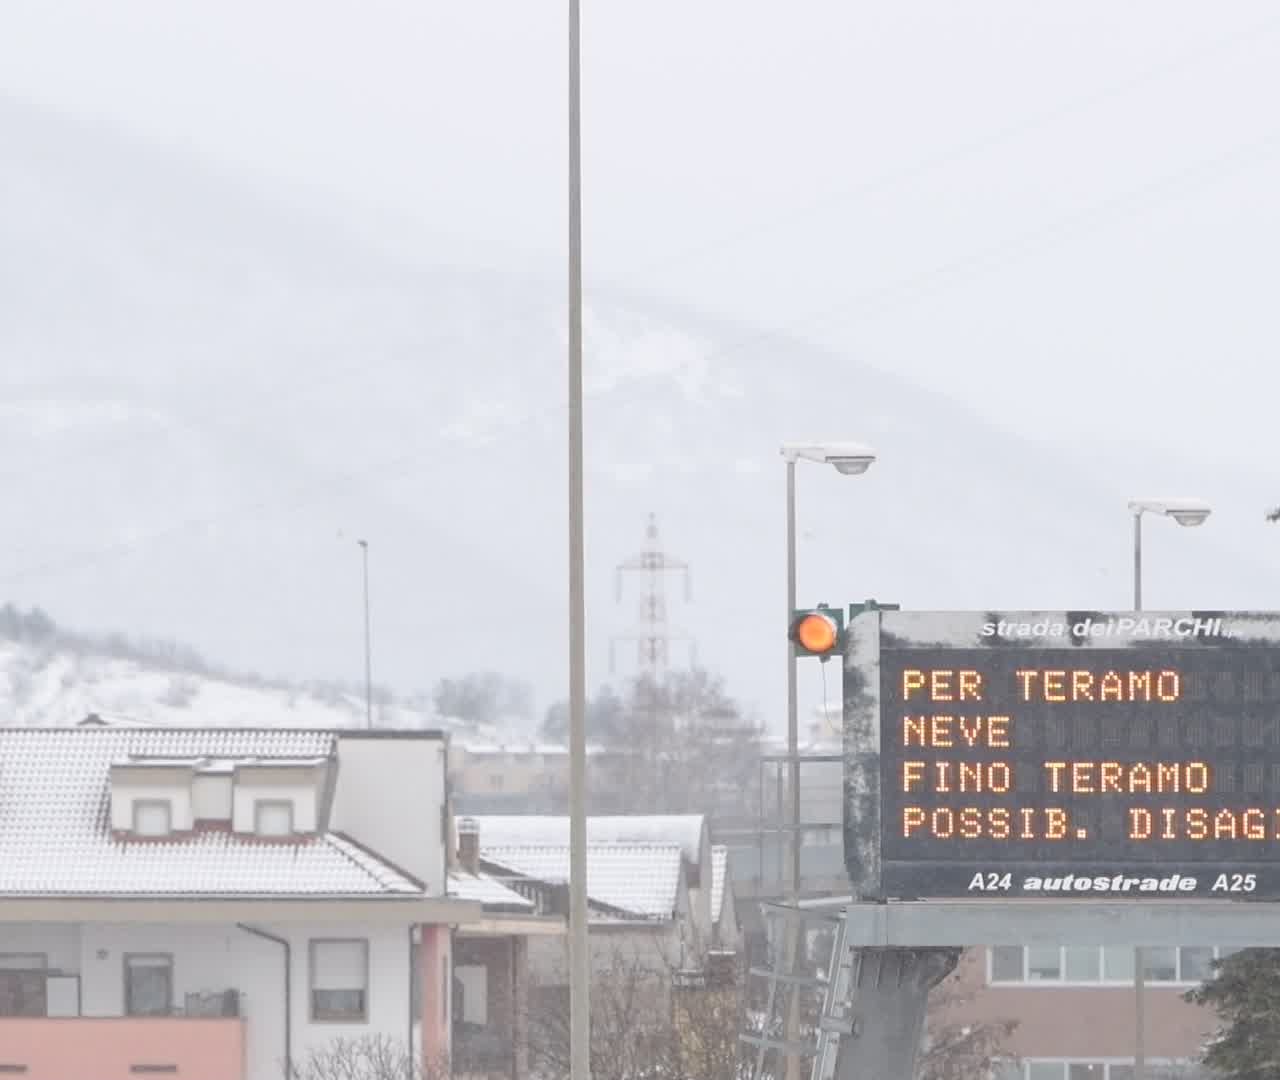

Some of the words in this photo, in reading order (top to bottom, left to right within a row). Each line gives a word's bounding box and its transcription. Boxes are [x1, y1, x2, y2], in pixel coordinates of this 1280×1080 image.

[982, 618, 1064, 636] strada
[1116, 618, 1221, 636] PARCHI
[903, 670, 982, 700] PER
[1016, 670, 1180, 700] TERAMO
[903, 716, 1010, 746] NEVE
[903, 762, 1010, 792] FINO
[1044, 762, 1208, 792] TERAMO
[903, 808, 1087, 838] POSSIB.
[968, 872, 1012, 891] A24
[1023, 874, 1198, 892] autostrade
[1211, 873, 1257, 892] A25
